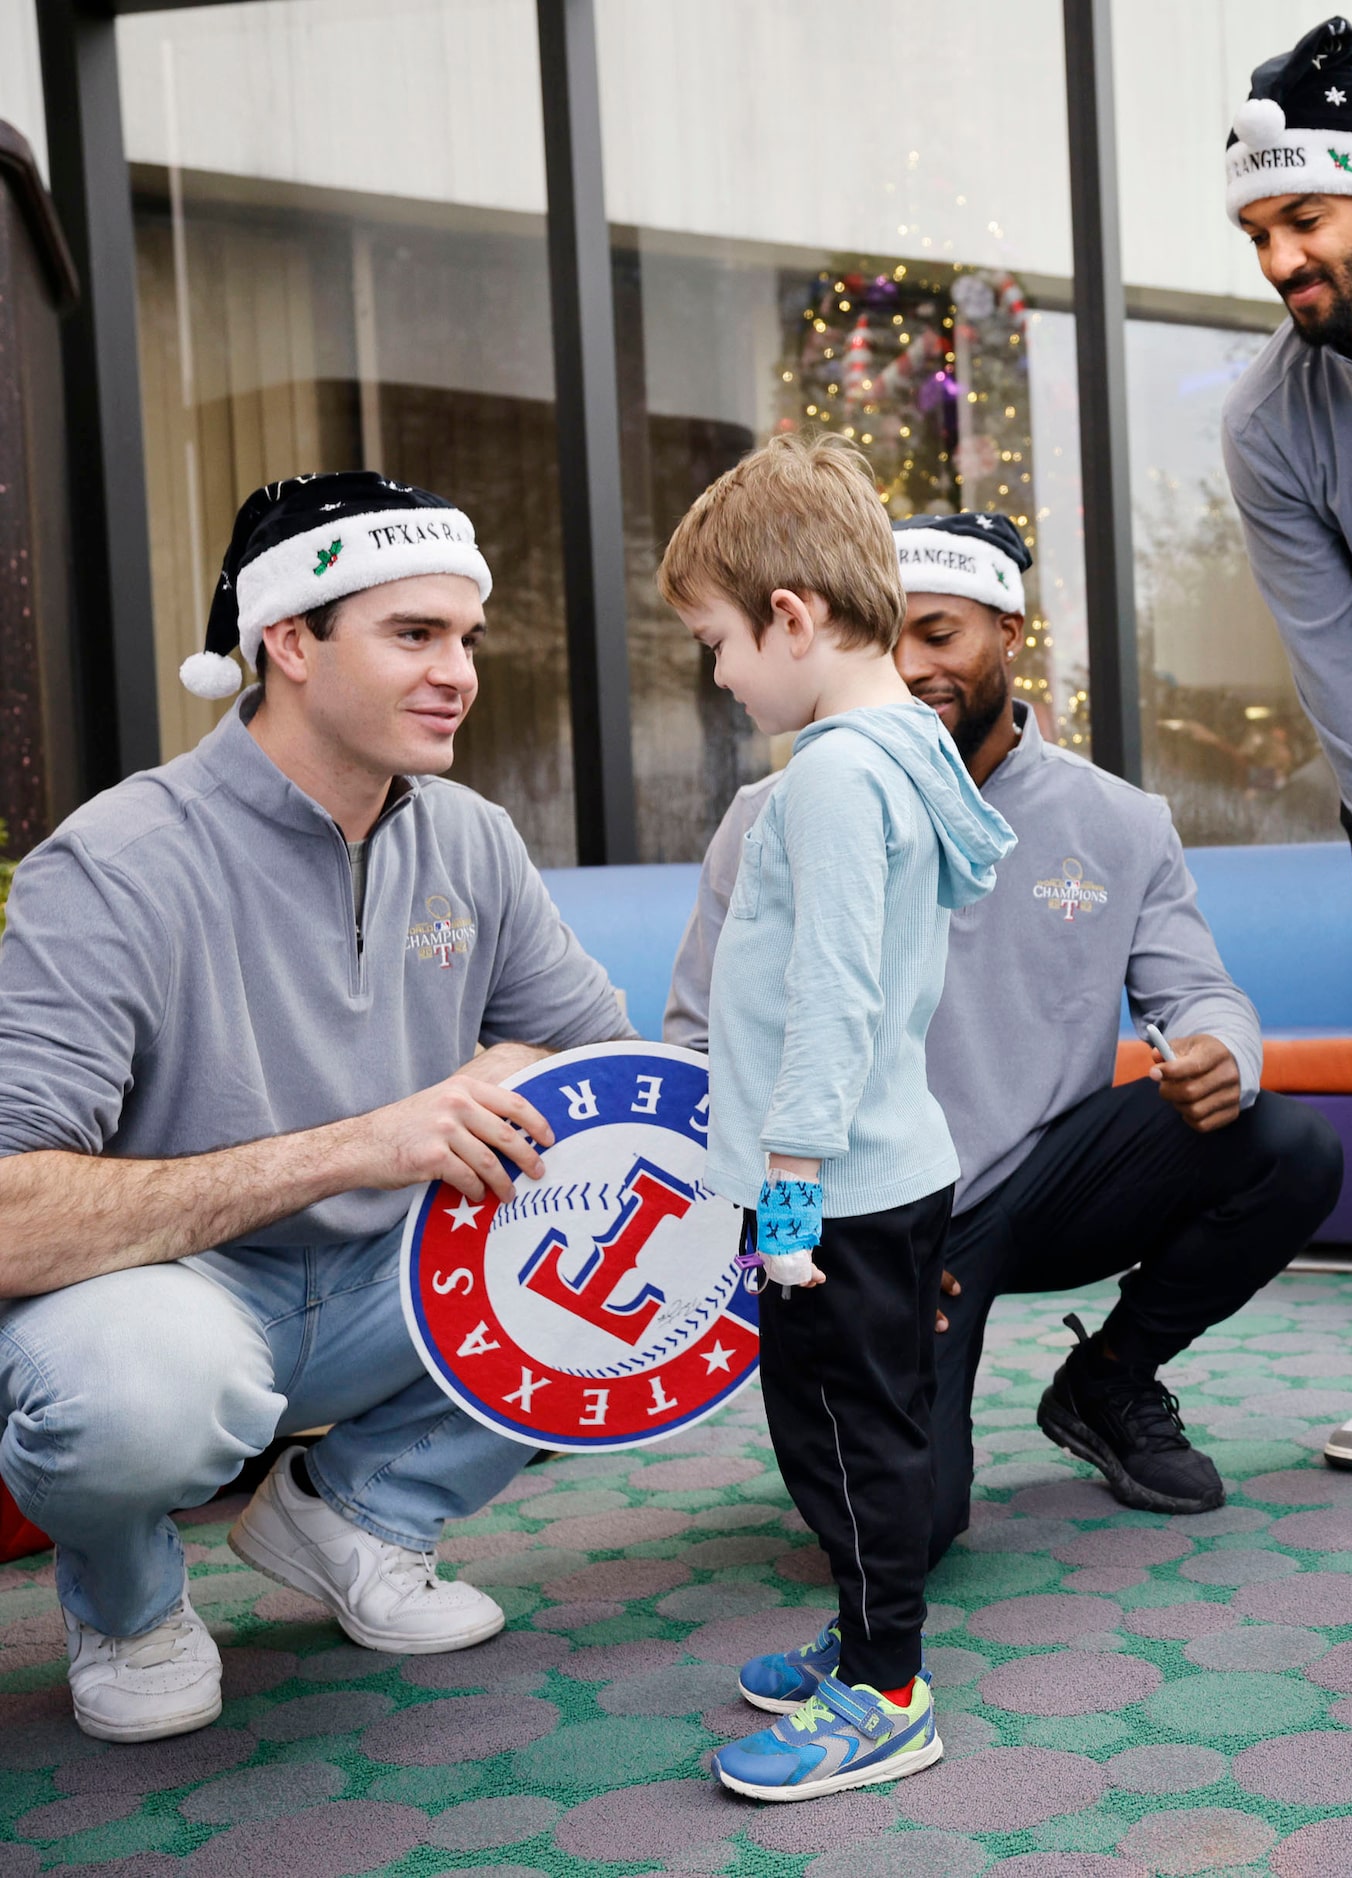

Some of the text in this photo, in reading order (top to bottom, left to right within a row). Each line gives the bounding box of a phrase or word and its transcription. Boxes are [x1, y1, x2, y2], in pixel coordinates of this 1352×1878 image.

[369, 524, 438, 549] TEXAS
[899, 548, 976, 574] RANGERS
[1033, 885, 1108, 903] CHAMPIONS
[432, 1267, 679, 1426] TEXAS
